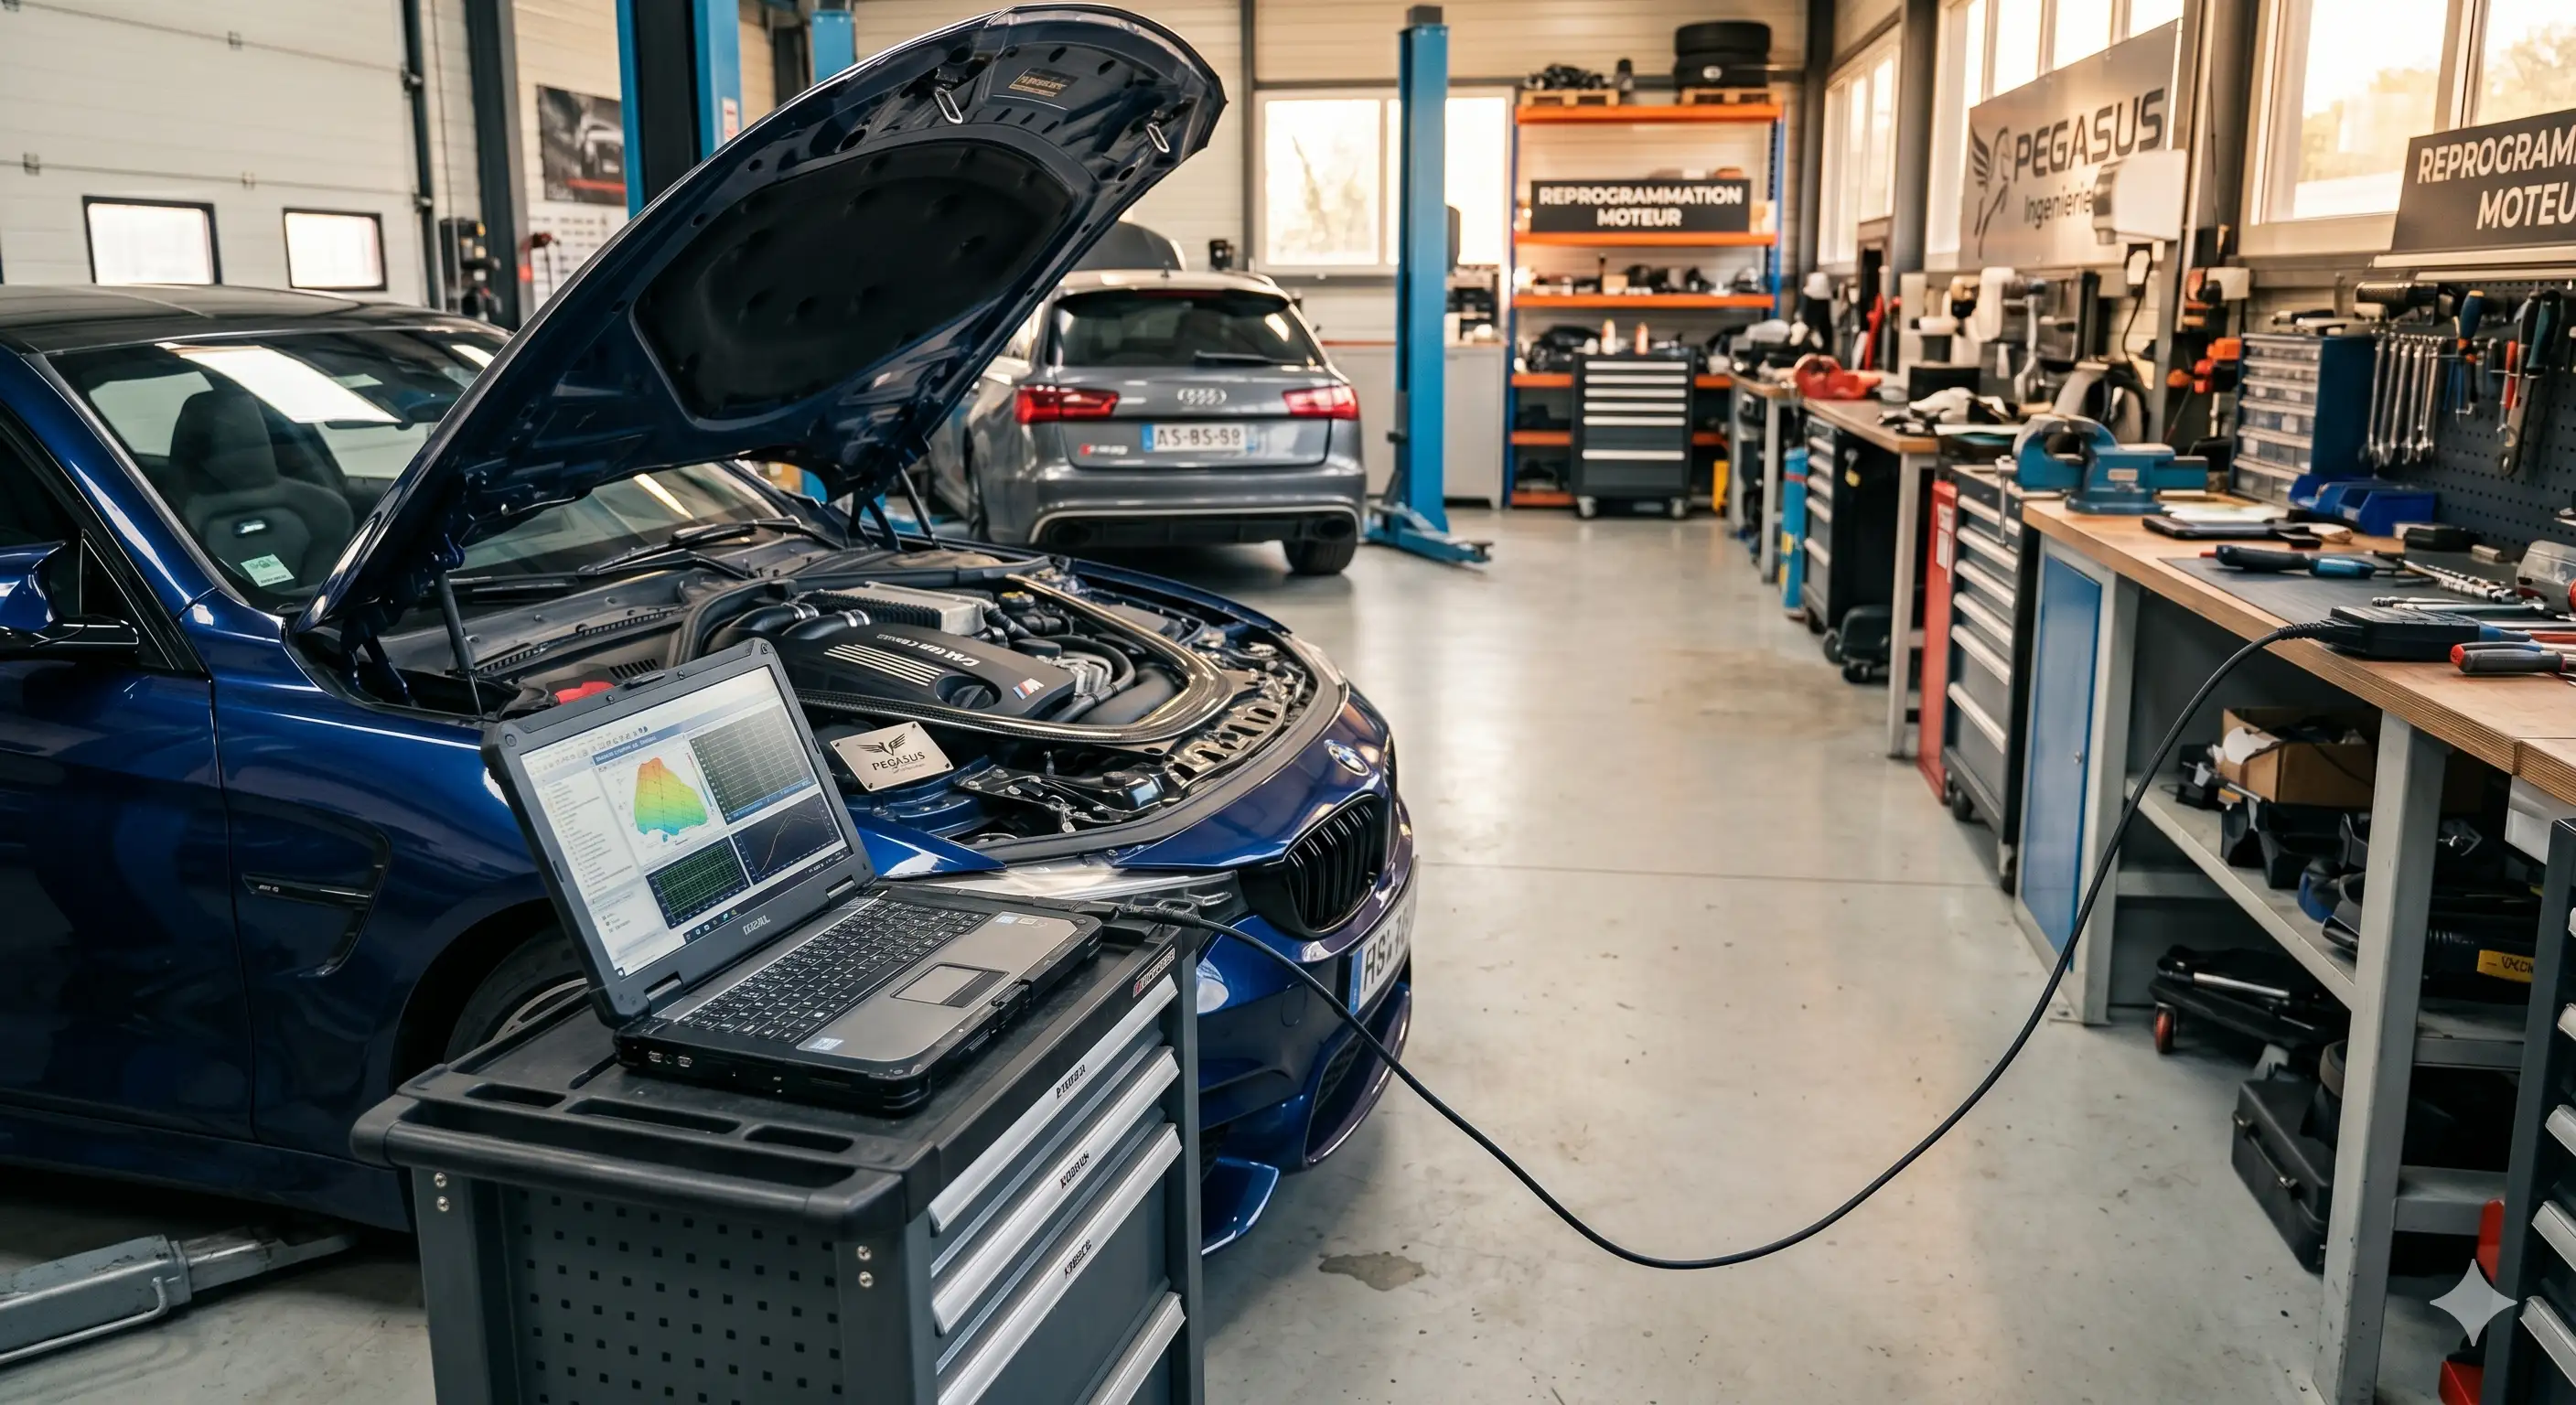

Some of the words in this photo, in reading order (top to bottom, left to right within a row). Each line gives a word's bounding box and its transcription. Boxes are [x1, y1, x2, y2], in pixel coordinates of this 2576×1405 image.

[2014, 87, 2164, 182] PEGASUS
[2417, 124, 2576, 184] REPROGRAM
[1539, 186, 1743, 205] REPROGRAMMATION
[1597, 207, 1682, 227] MOTEUR
[872, 751, 925, 770] PEGASUS
